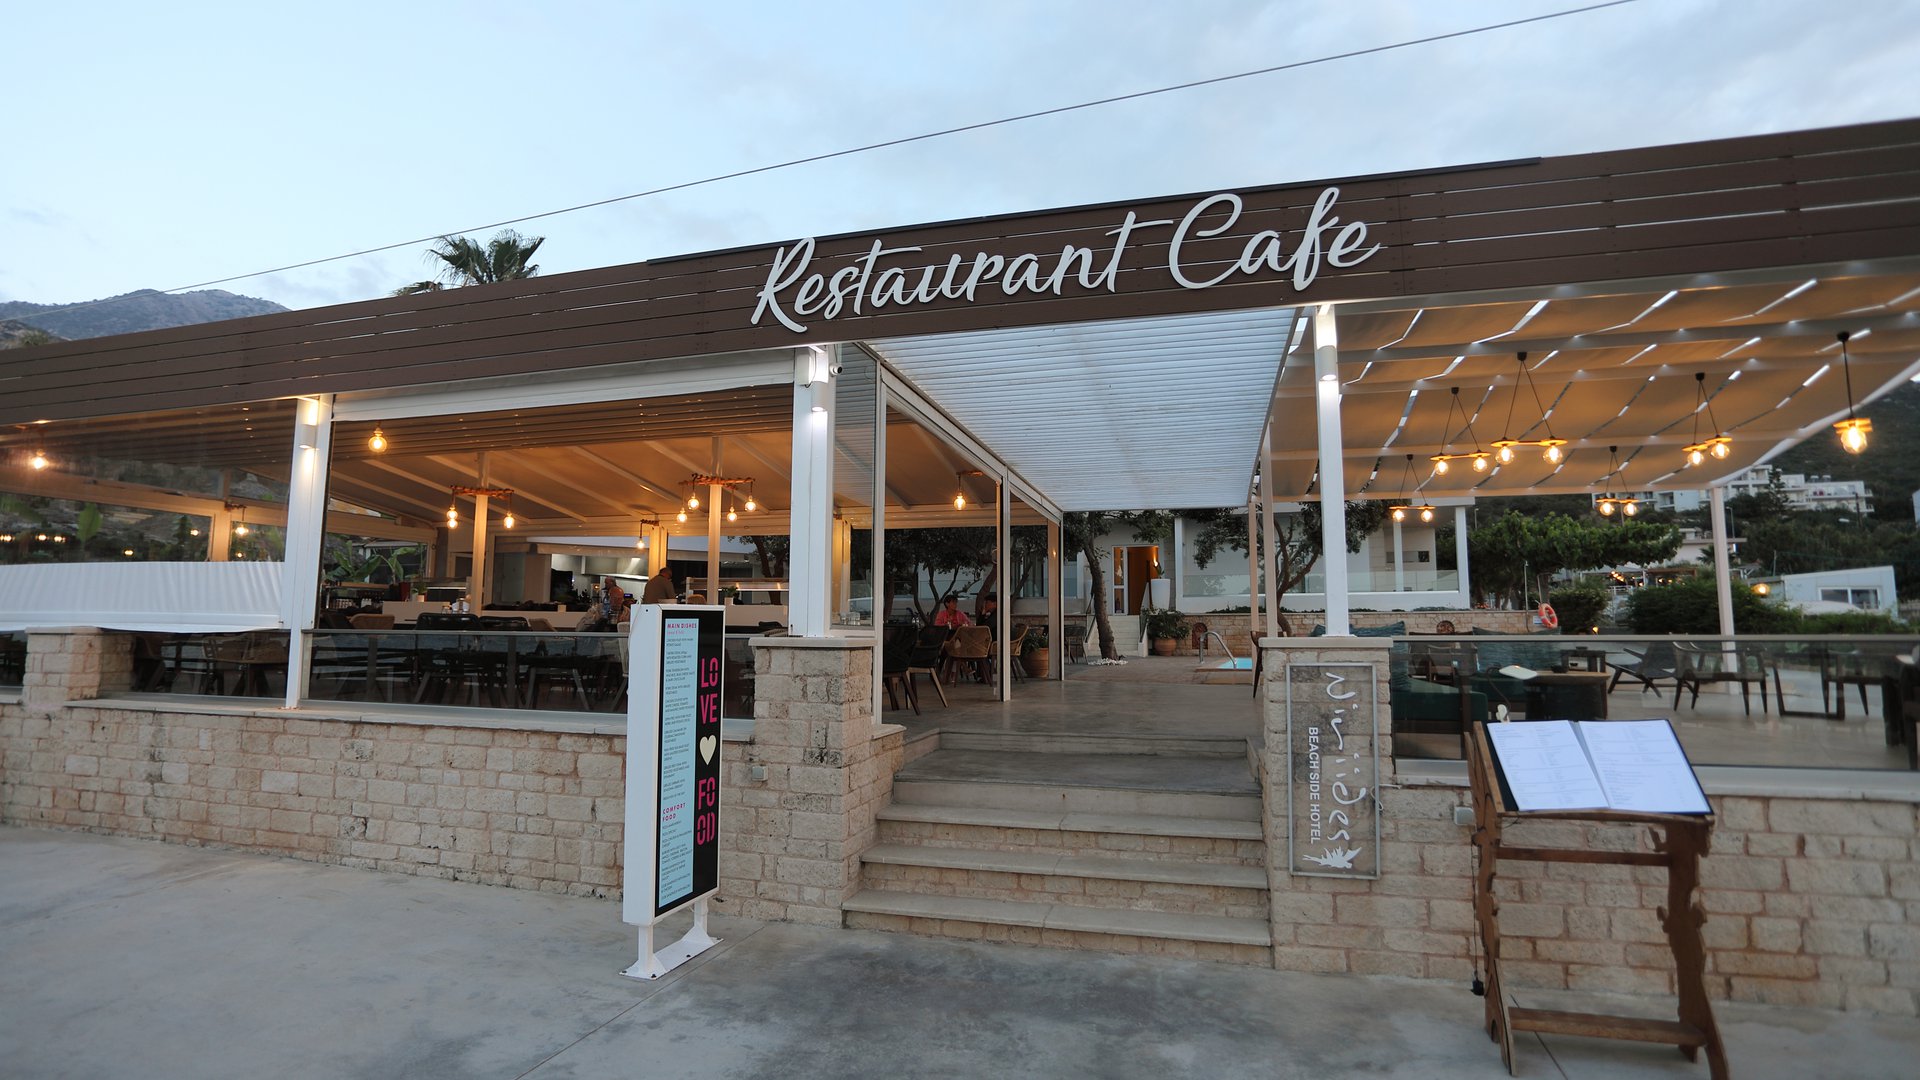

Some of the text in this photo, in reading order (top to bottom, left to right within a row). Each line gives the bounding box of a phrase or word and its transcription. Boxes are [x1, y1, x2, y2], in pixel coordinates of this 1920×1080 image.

[750, 186, 1381, 333] Restaurant Cafe
[662, 802, 686, 814] COMFORT
[662, 813, 677, 822] FOOD
[1308, 726, 1321, 845] BEACH SIDE HOTEL
